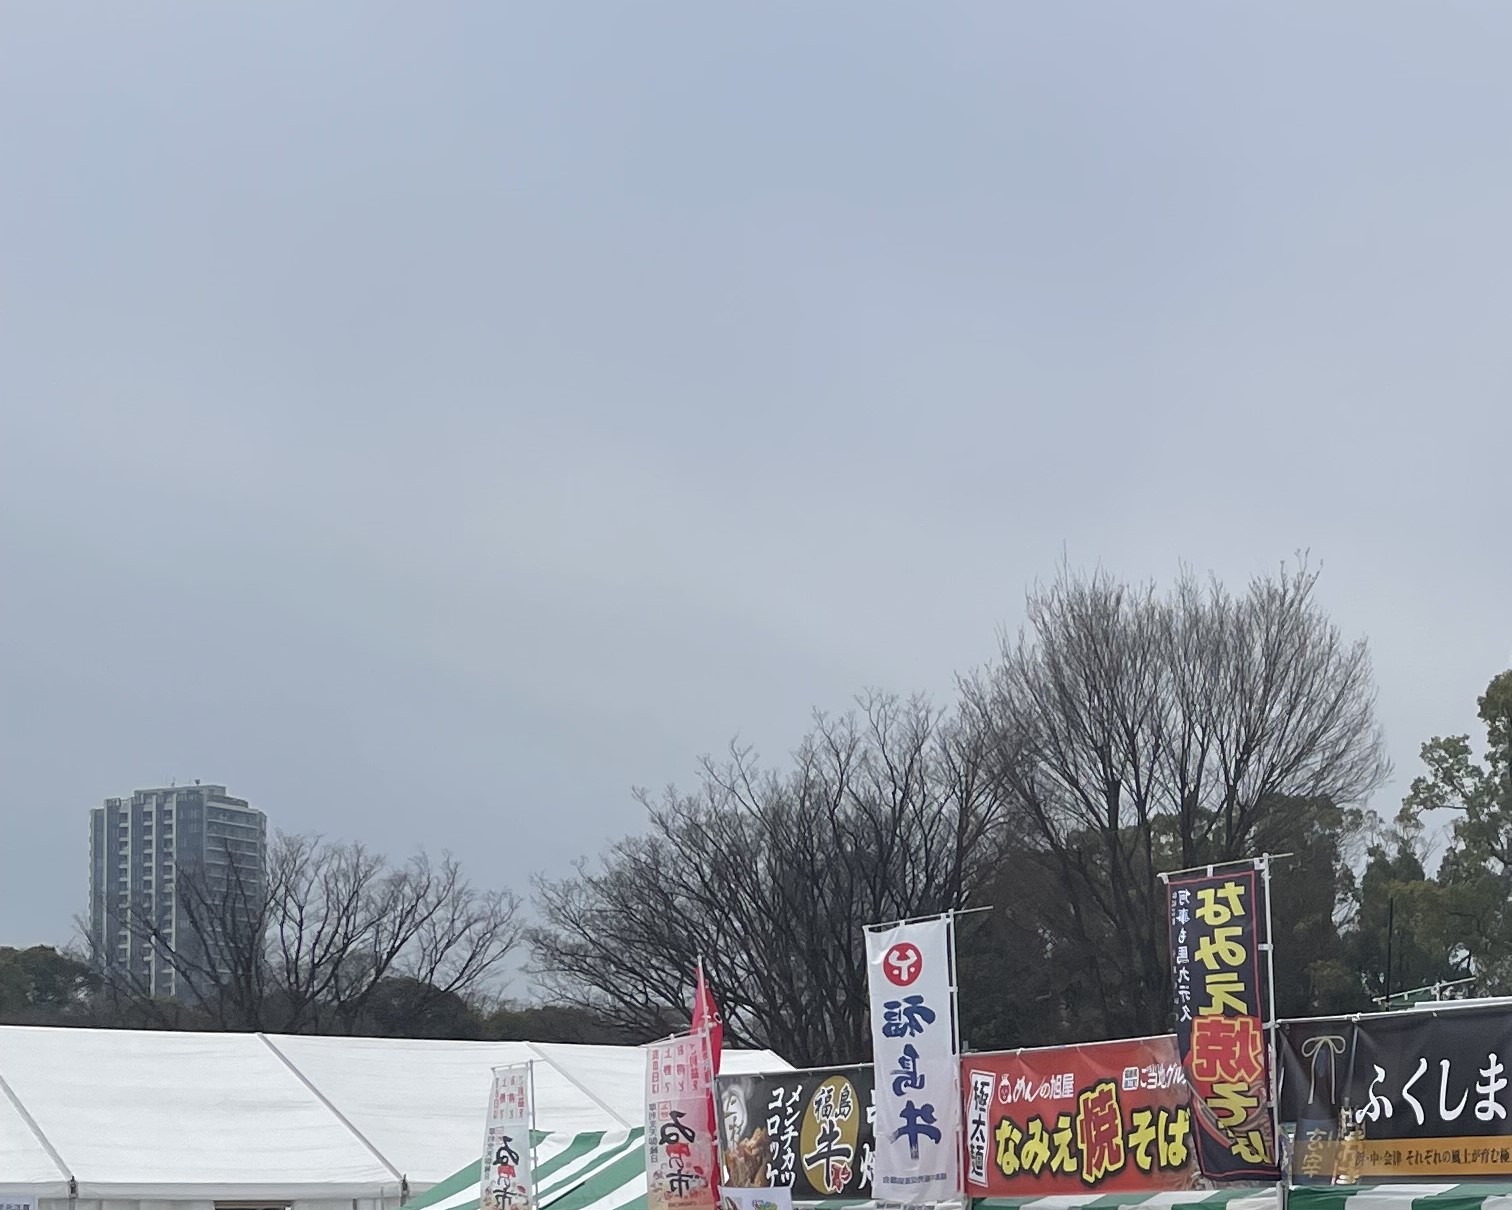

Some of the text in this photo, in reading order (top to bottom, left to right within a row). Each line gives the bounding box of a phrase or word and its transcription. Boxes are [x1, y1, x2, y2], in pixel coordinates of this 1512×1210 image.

[767, 1087, 784, 1188] コロッケ
[781, 1085, 802, 1188] メンチカツ
[813, 1083, 853, 1122] 福島
[970, 1079, 991, 1177] 極太麺
[995, 1084, 1190, 1182] なみえ焼そば
[803, 1120, 853, 1190] 牛
